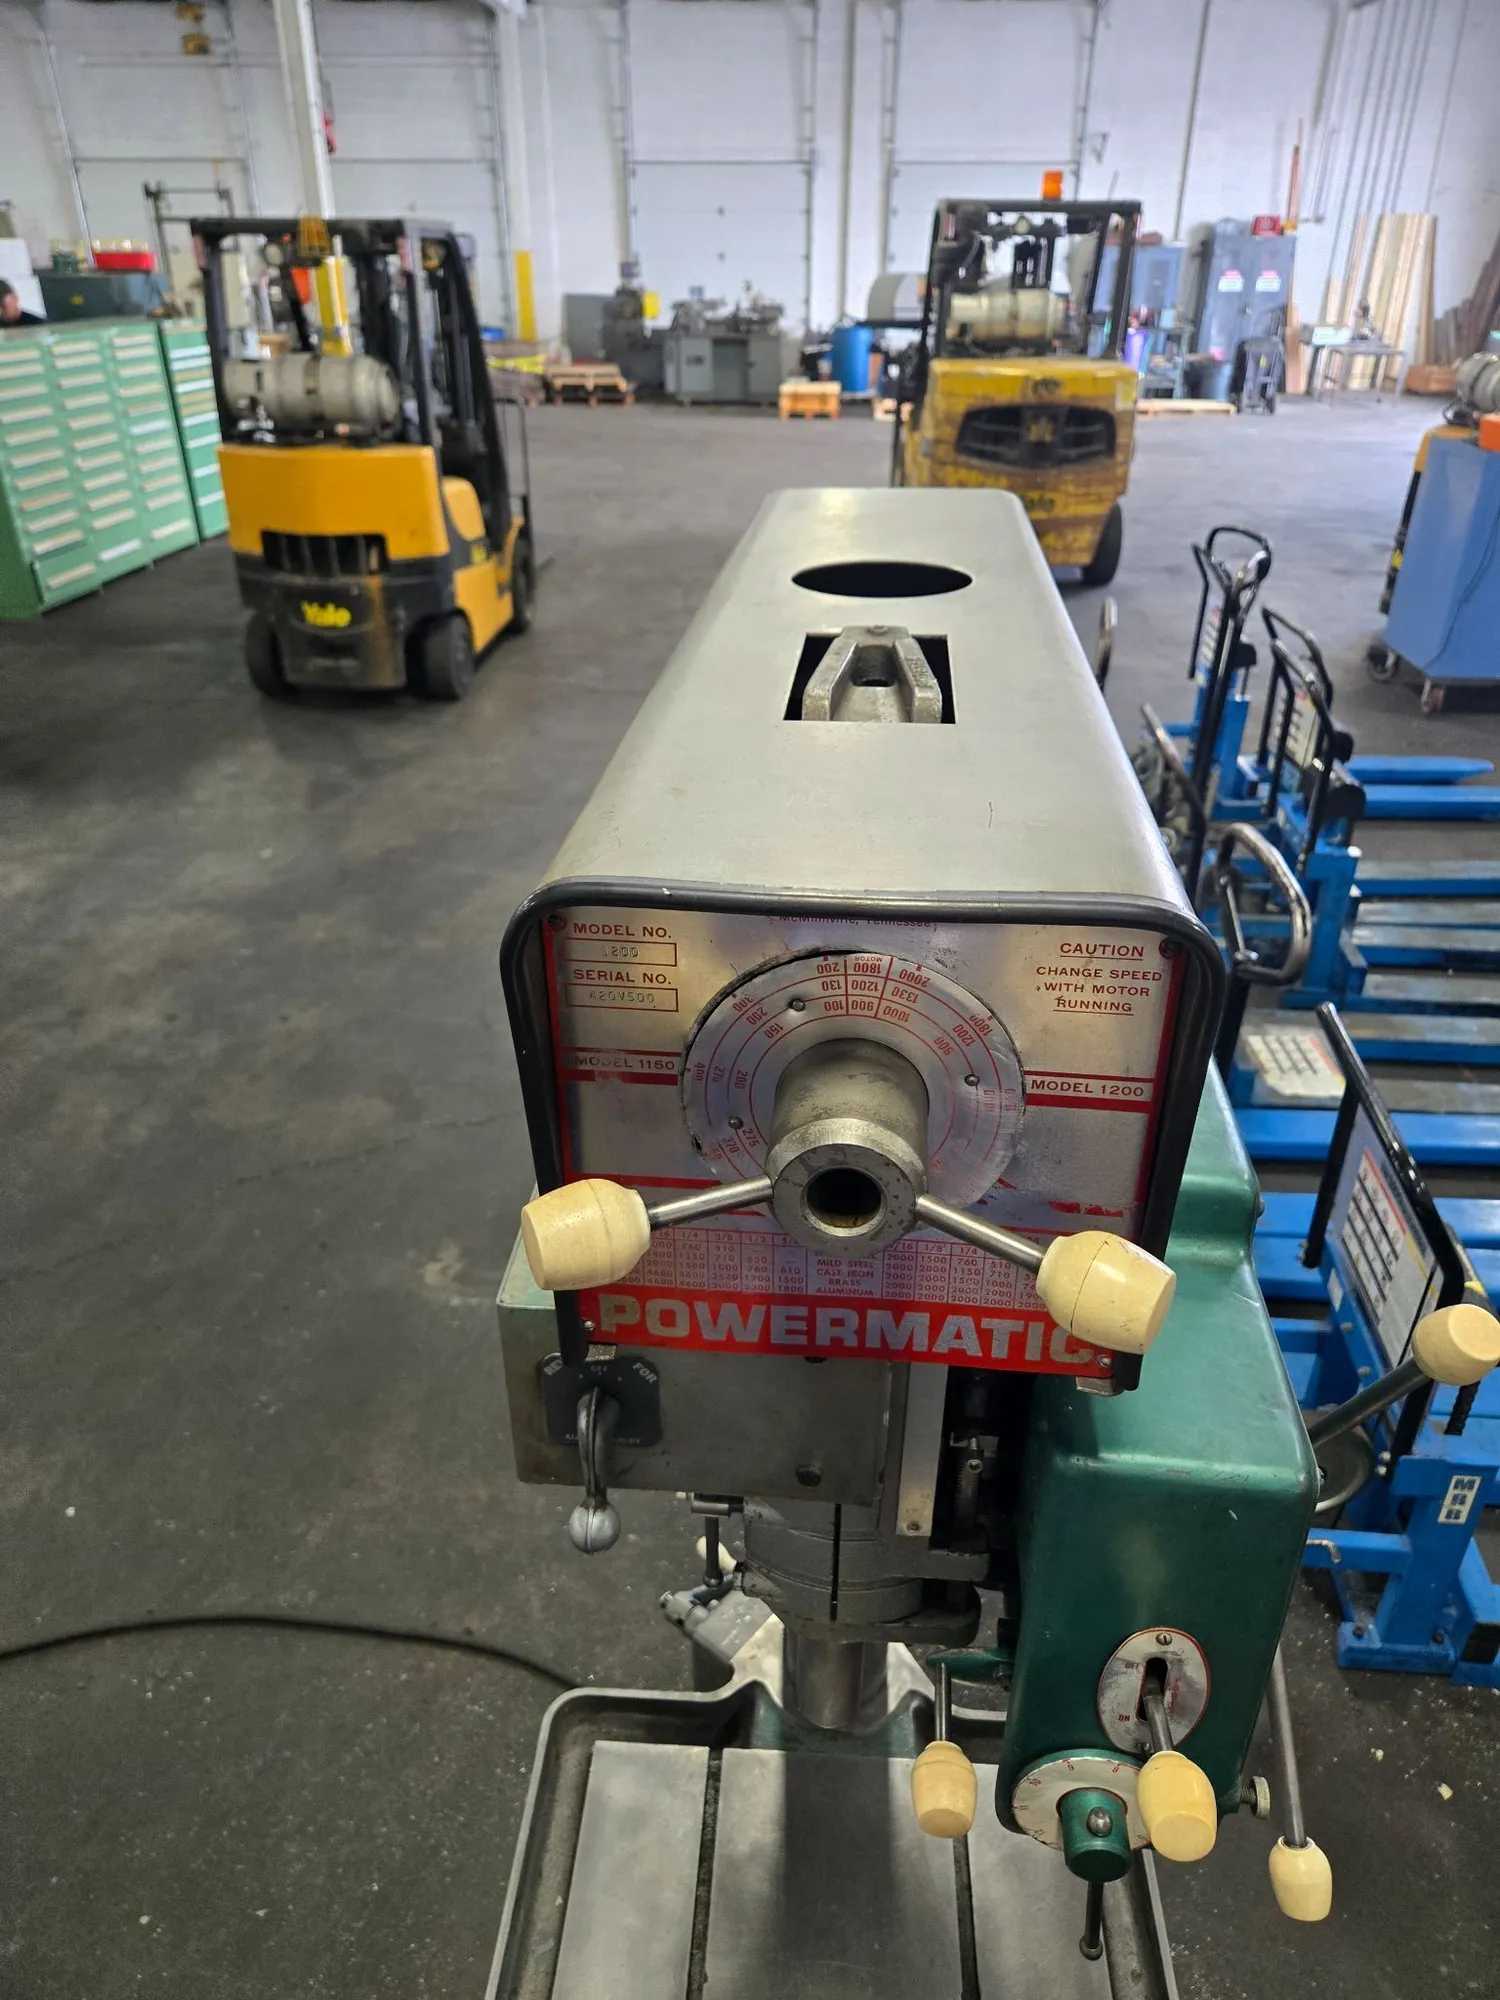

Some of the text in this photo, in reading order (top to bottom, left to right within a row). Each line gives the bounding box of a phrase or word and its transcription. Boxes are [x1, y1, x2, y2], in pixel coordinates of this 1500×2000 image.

[573, 923, 672, 939] MODEL NO.
[1059, 942, 1145, 957] CAUTION
[573, 968, 672, 985] SERIAL NO.
[817, 962, 931, 988] 200 1800 2000
[1036, 966, 1163, 981] CHANGE SPEED
[821, 979, 920, 1004] 130 1200 1330
[1043, 982, 1150, 997] WITH MOTOR
[823, 1000, 911, 1023] 100 900 1000
[1056, 998, 1132, 1012] RUNNING
[763, 1022, 785, 1039] 150
[952, 1024, 977, 1047] 1200
[574, 1056, 675, 1071] MODEL 1150
[1030, 1078, 1145, 1097] MODEL 1200
